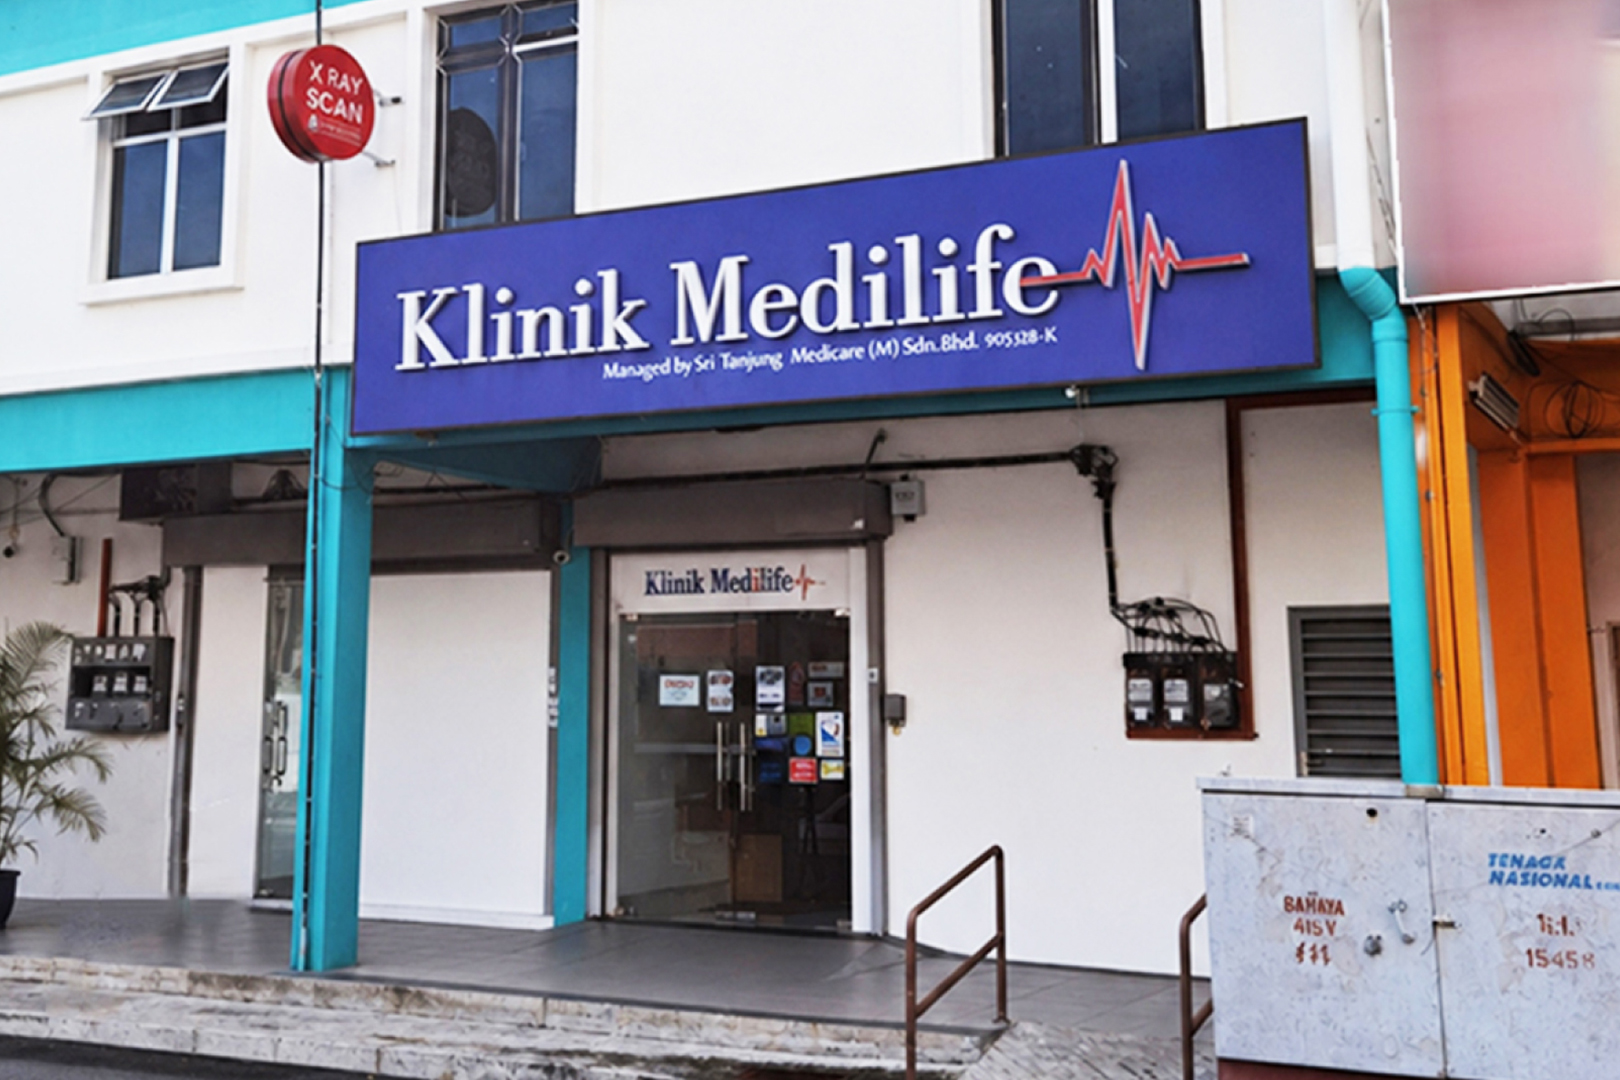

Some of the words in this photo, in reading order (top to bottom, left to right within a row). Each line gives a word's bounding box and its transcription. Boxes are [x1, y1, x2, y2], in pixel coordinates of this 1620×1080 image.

[309, 60, 323, 85] X
[327, 67, 363, 95] RAY
[306, 87, 363, 125] SCAN
[395, 268, 650, 371] Klinik
[669, 224, 1058, 345] Medilife
[603, 357, 671, 382] Managed
[674, 356, 692, 378] by
[694, 354, 715, 373] Sri
[720, 351, 783, 372] Tanjung
[790, 343, 865, 364] Medicare
[868, 338, 899, 360] (M)
[645, 569, 705, 596] Klinik
[711, 566, 794, 593] Medilife
[1488, 853, 1565, 870] TENAGA
[1489, 870, 1593, 890] NASIONAL
[1284, 895, 1345, 917] BAHAYA
